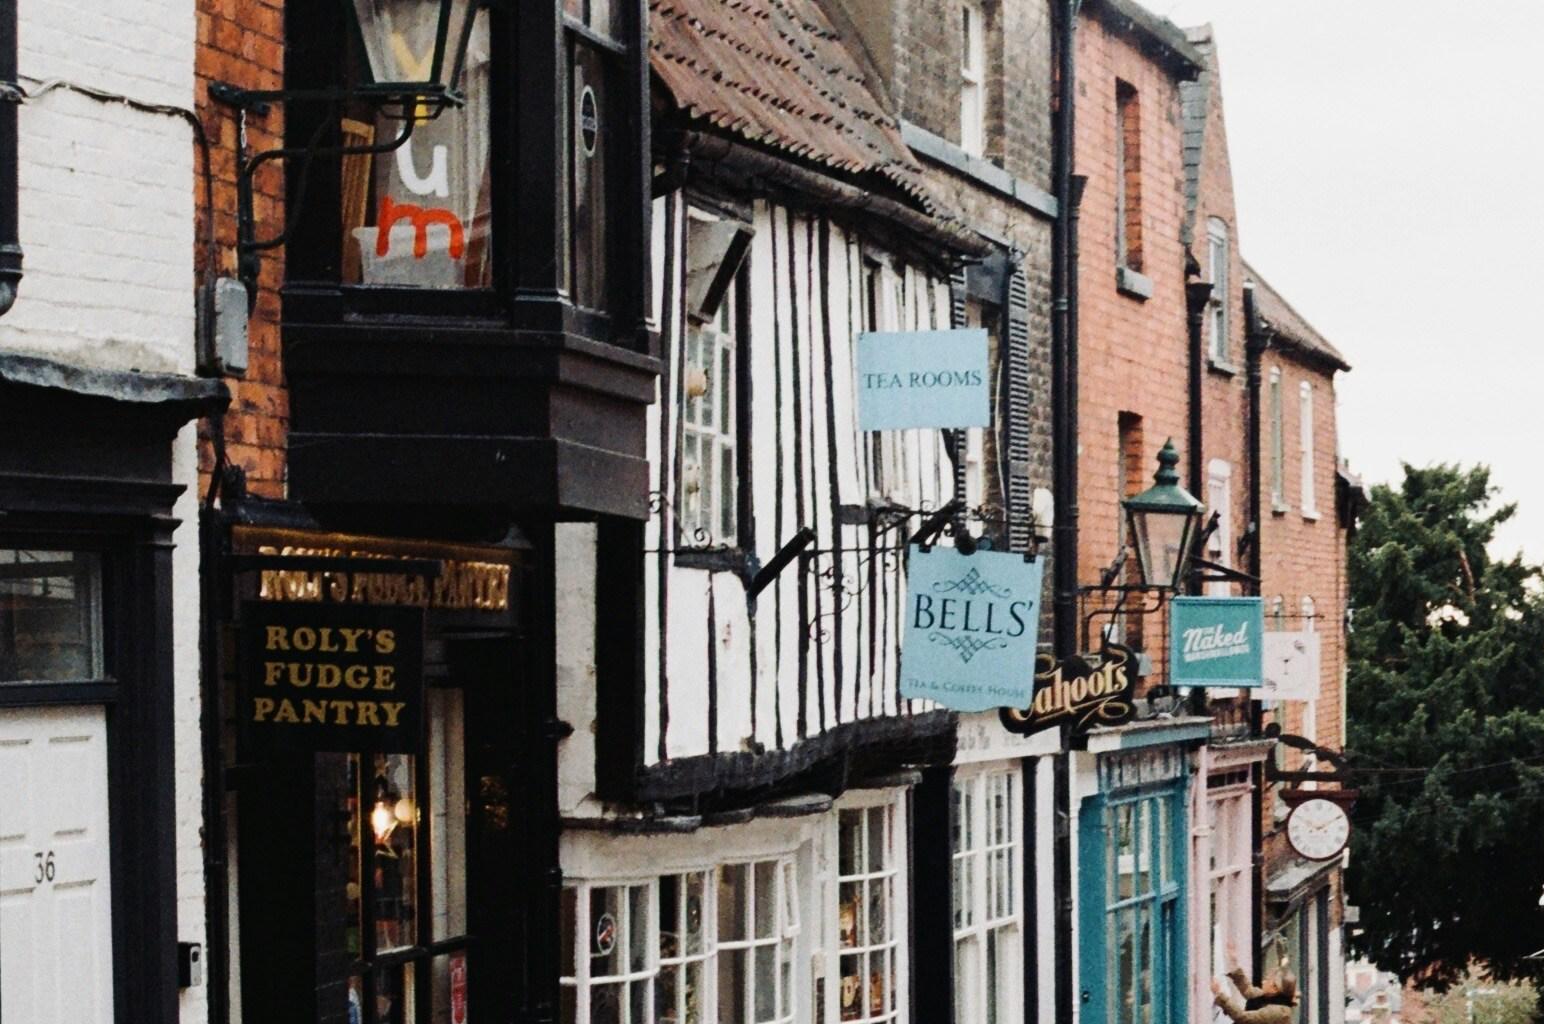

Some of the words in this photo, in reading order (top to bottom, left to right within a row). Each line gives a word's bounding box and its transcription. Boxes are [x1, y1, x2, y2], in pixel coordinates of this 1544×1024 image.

[863, 372, 903, 389] TEA
[909, 370, 983, 388] ROOMS
[913, 593, 1034, 638] BELLS'
[265, 625, 397, 654] ROLY'S
[264, 661, 396, 691] FUDGE
[253, 697, 406, 727] PANTRY
[34, 850, 55, 884] 36
